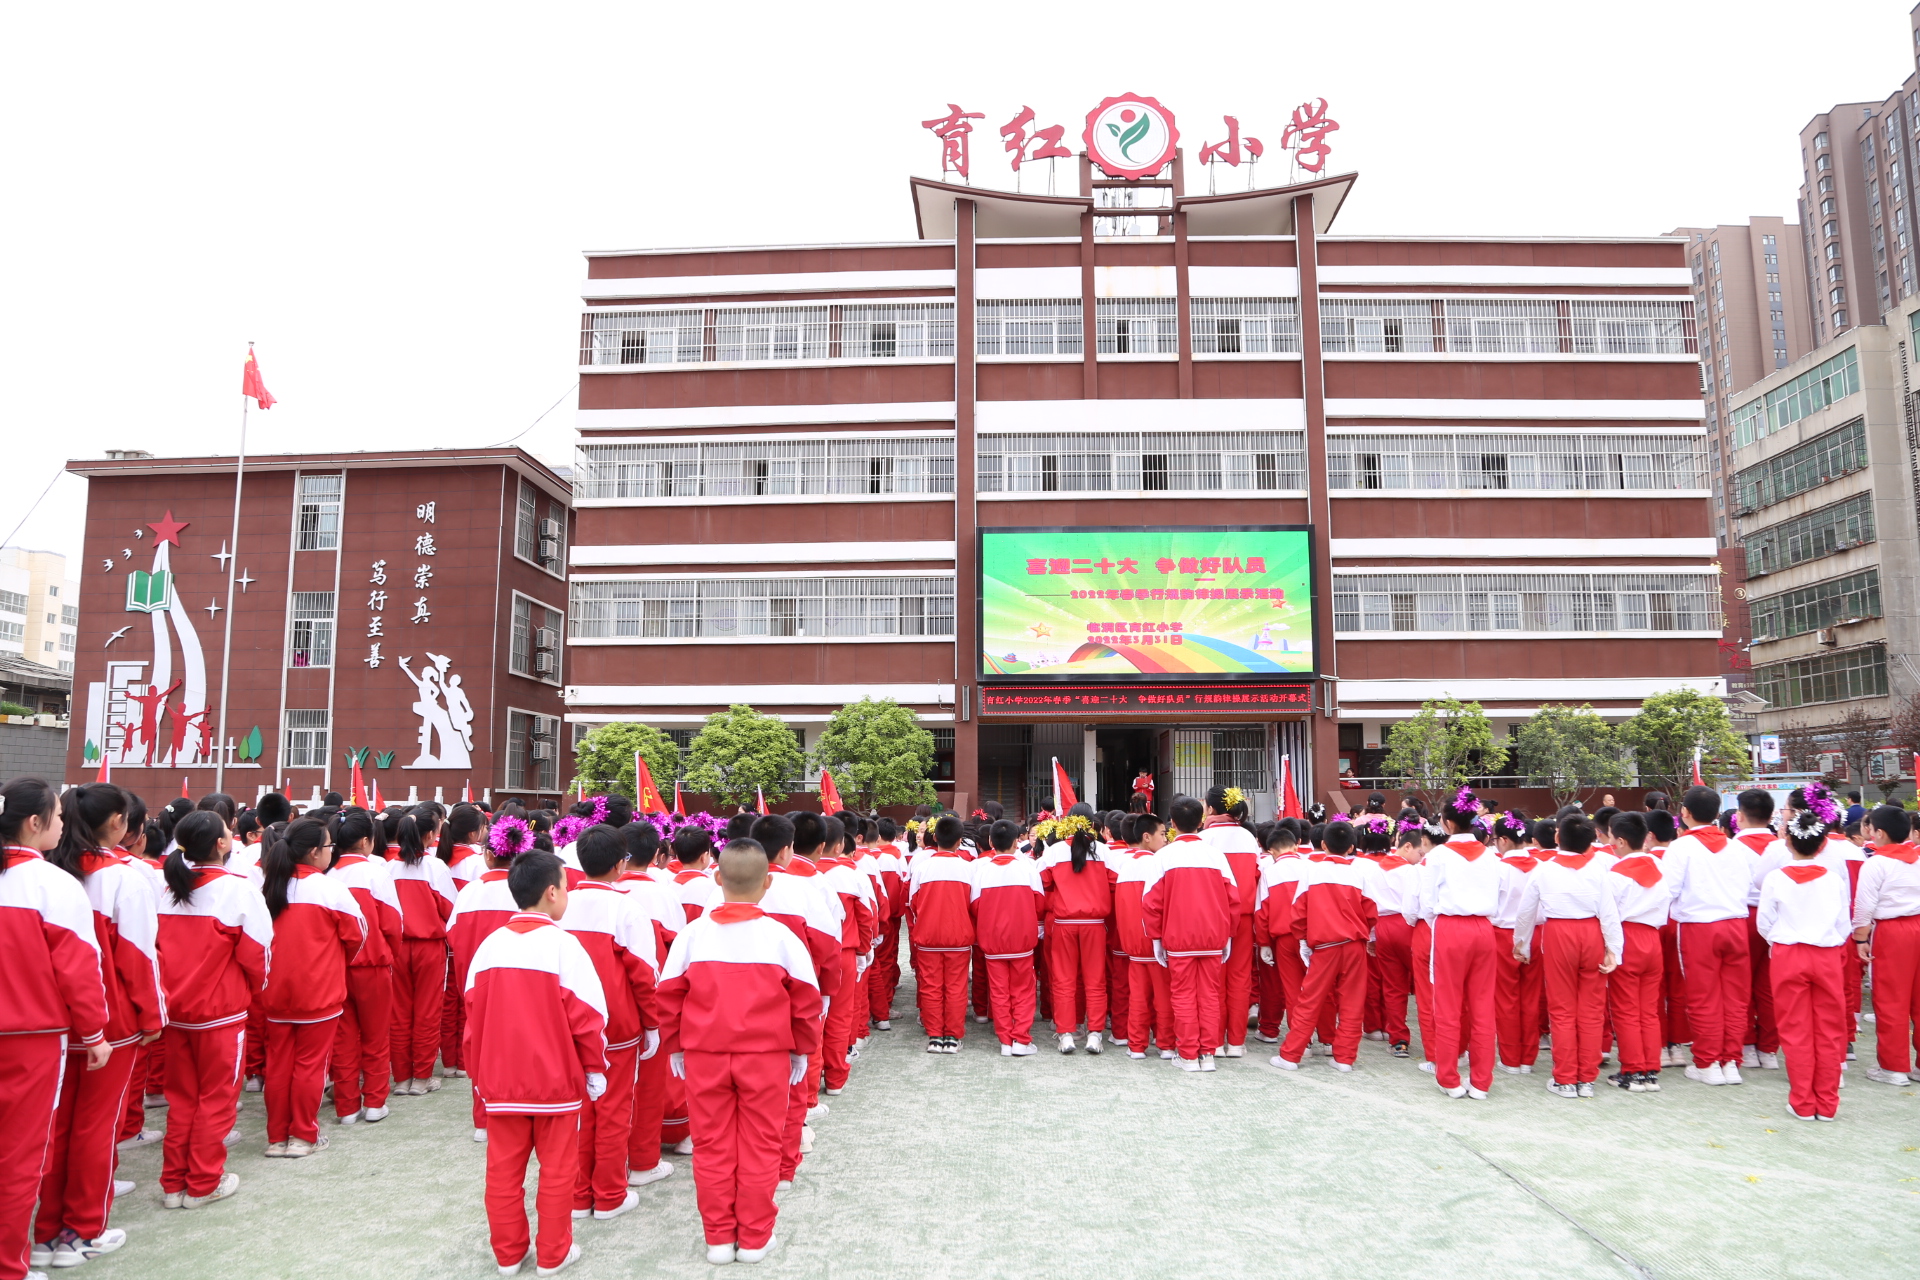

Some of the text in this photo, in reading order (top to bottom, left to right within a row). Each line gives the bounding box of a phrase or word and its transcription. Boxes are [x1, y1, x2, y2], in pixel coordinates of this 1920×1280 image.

[411, 500, 436, 624] 明德崇真
[1026, 556, 1267, 575] 喜迎二十大 争做好队员
[364, 559, 388, 669] 笃行至善
[1087, 635, 1182, 645] 2022年3月31日
